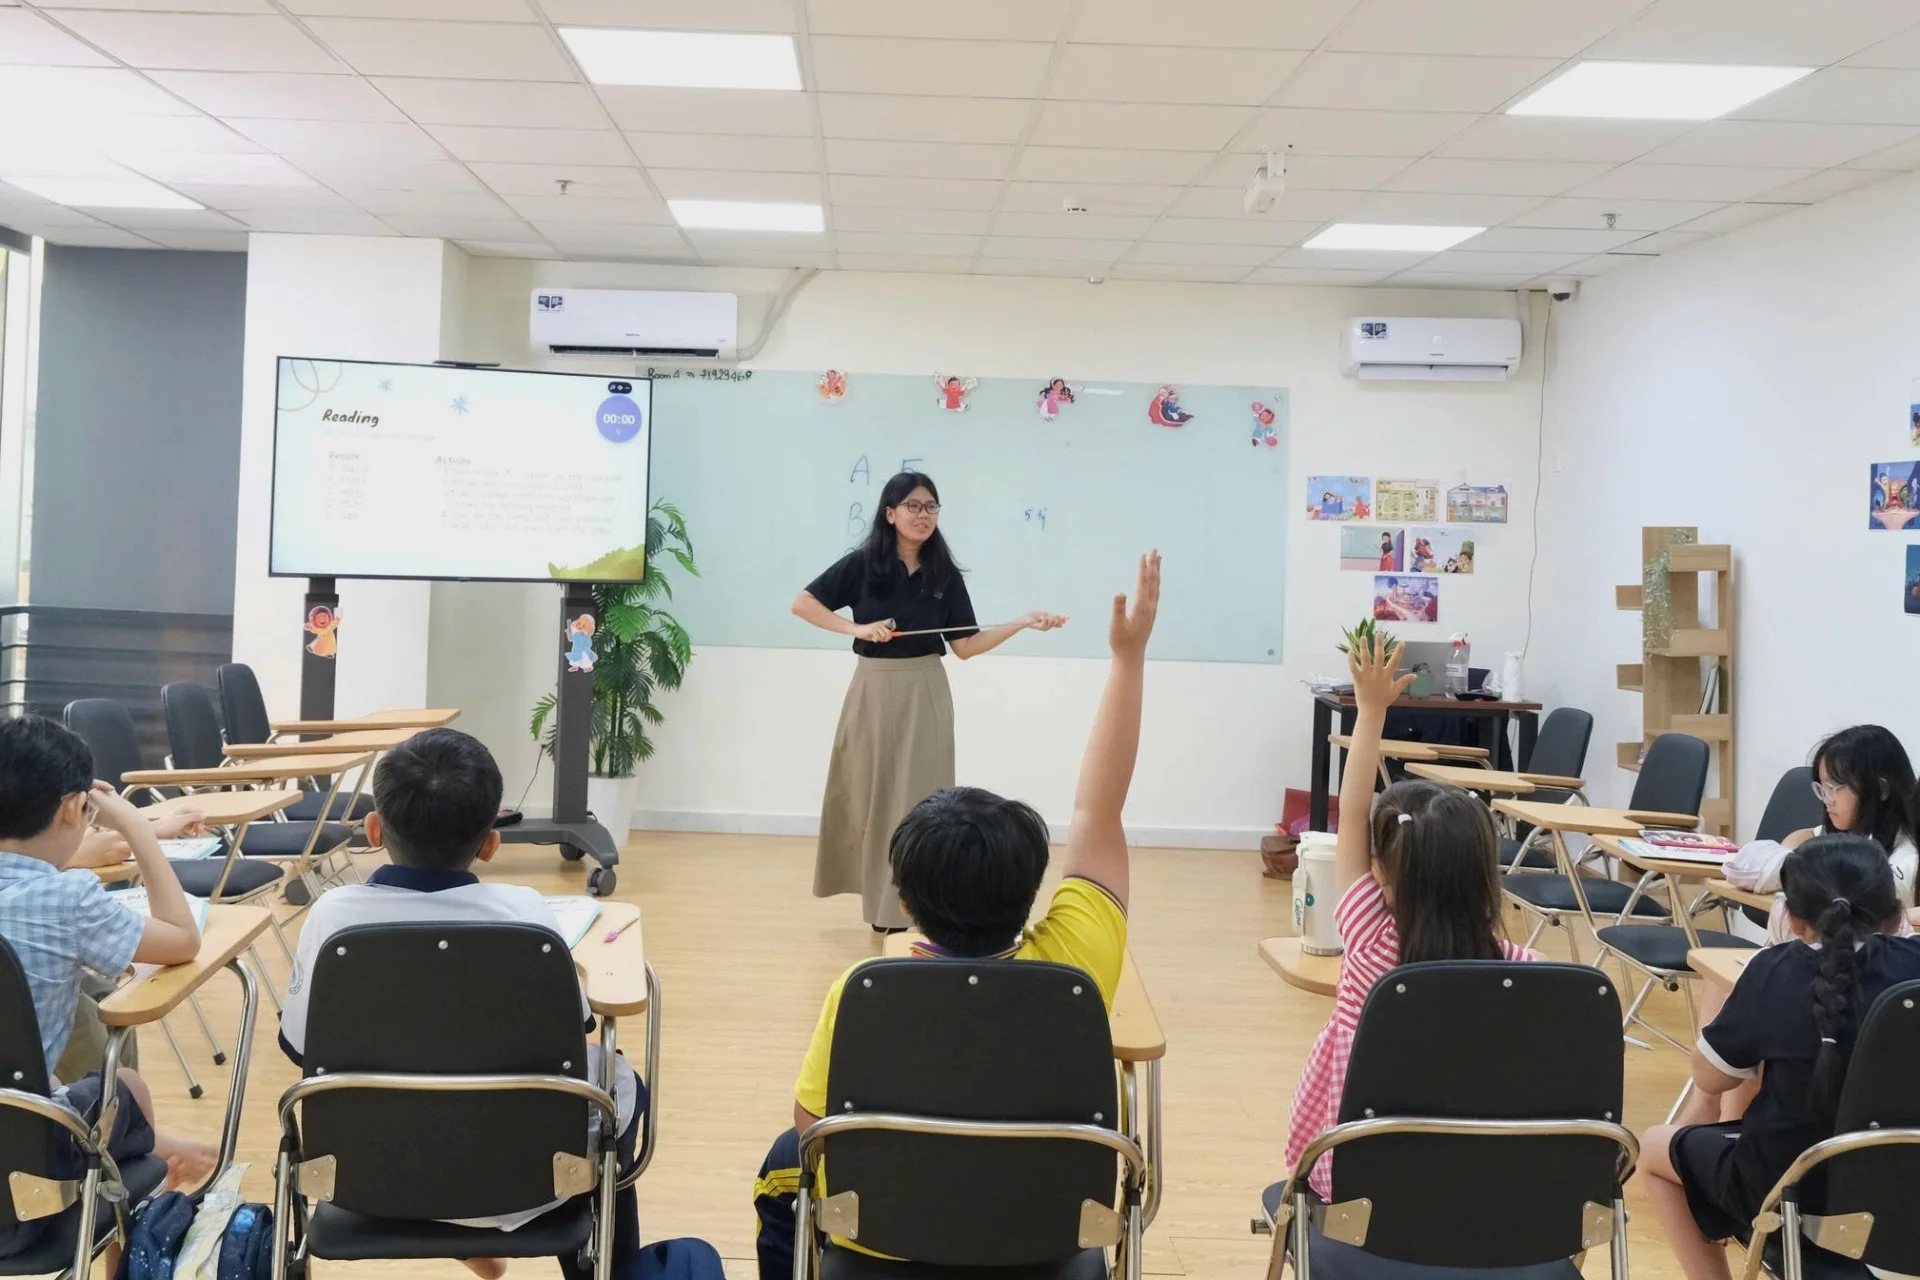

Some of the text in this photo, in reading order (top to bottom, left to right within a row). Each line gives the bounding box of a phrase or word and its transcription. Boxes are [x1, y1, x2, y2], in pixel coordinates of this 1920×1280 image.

[647, 367, 671, 380] Room
[322, 408, 379, 428] Reading
[603, 413, 636, 425] 00:00
[850, 455, 870, 486] A
